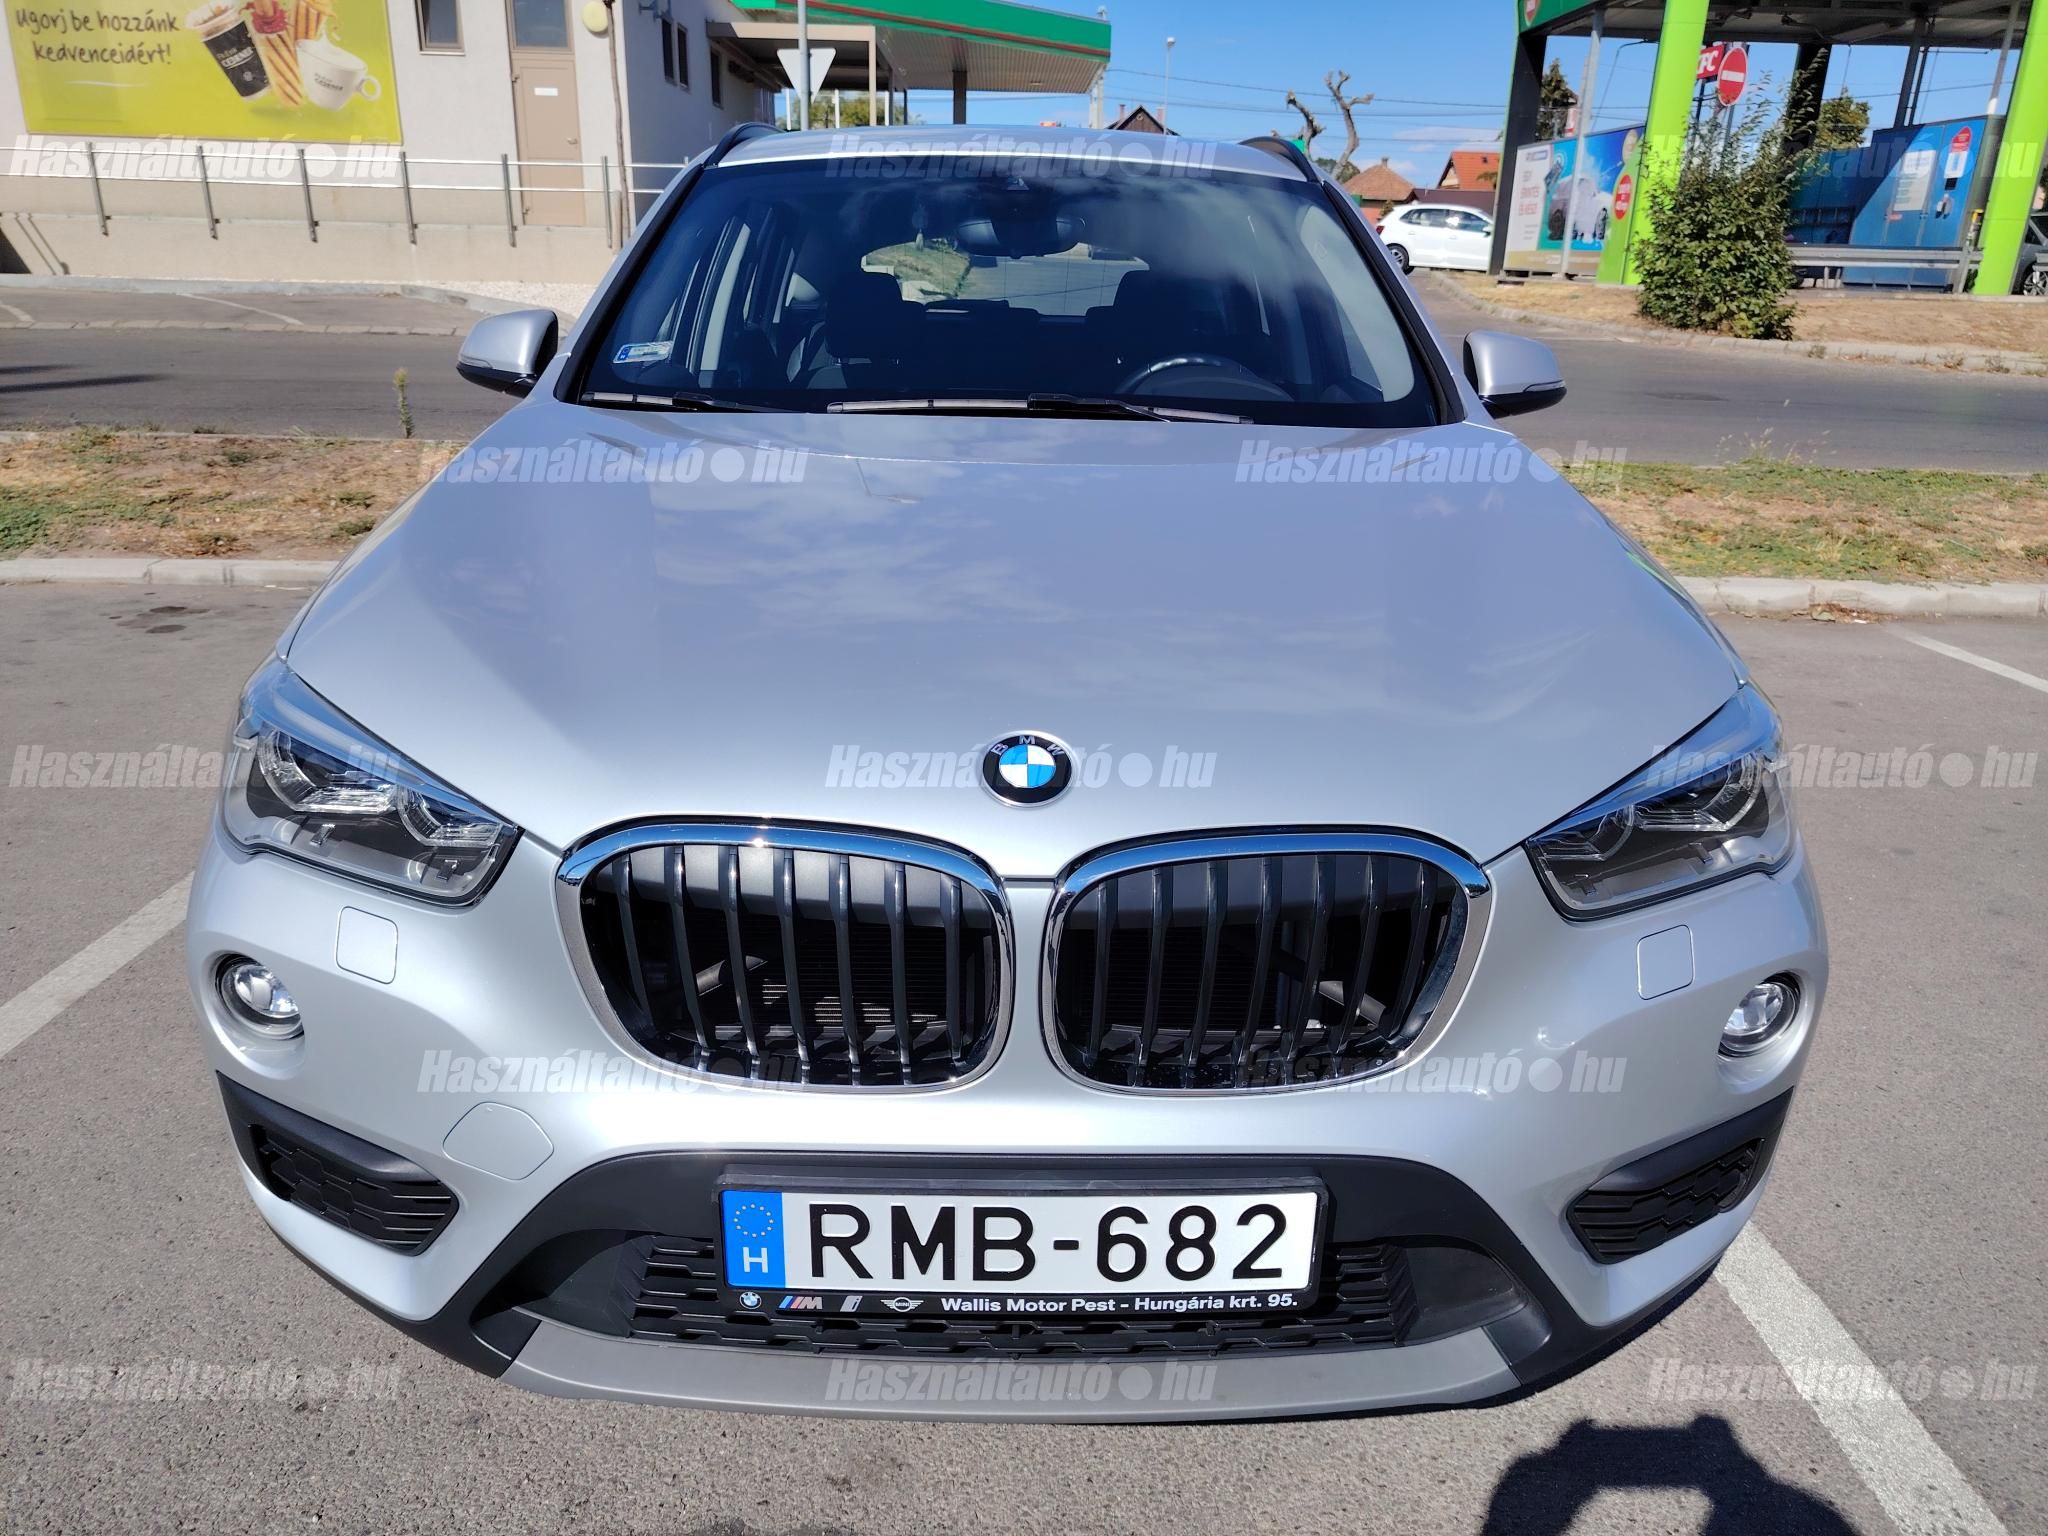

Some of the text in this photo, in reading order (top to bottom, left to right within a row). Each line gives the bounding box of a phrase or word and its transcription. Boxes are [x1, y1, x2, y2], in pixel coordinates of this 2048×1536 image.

[15, 8, 181, 35] Ugorj be hozzánk
[32, 41, 172, 65] kedvenceidért!
[990, 735, 1066, 756] BMW
[809, 1202, 1288, 1282] RMB-682
[743, 1246, 768, 1273] H
[941, 1298, 1001, 1311] Wallis
[1006, 1299, 1067, 1312] Motor
[1071, 1299, 1116, 1312] Pest
[1134, 1296, 1225, 1313] Hungária
[1229, 1295, 1262, 1309] krt.
[1268, 1293, 1298, 1307] 95.
